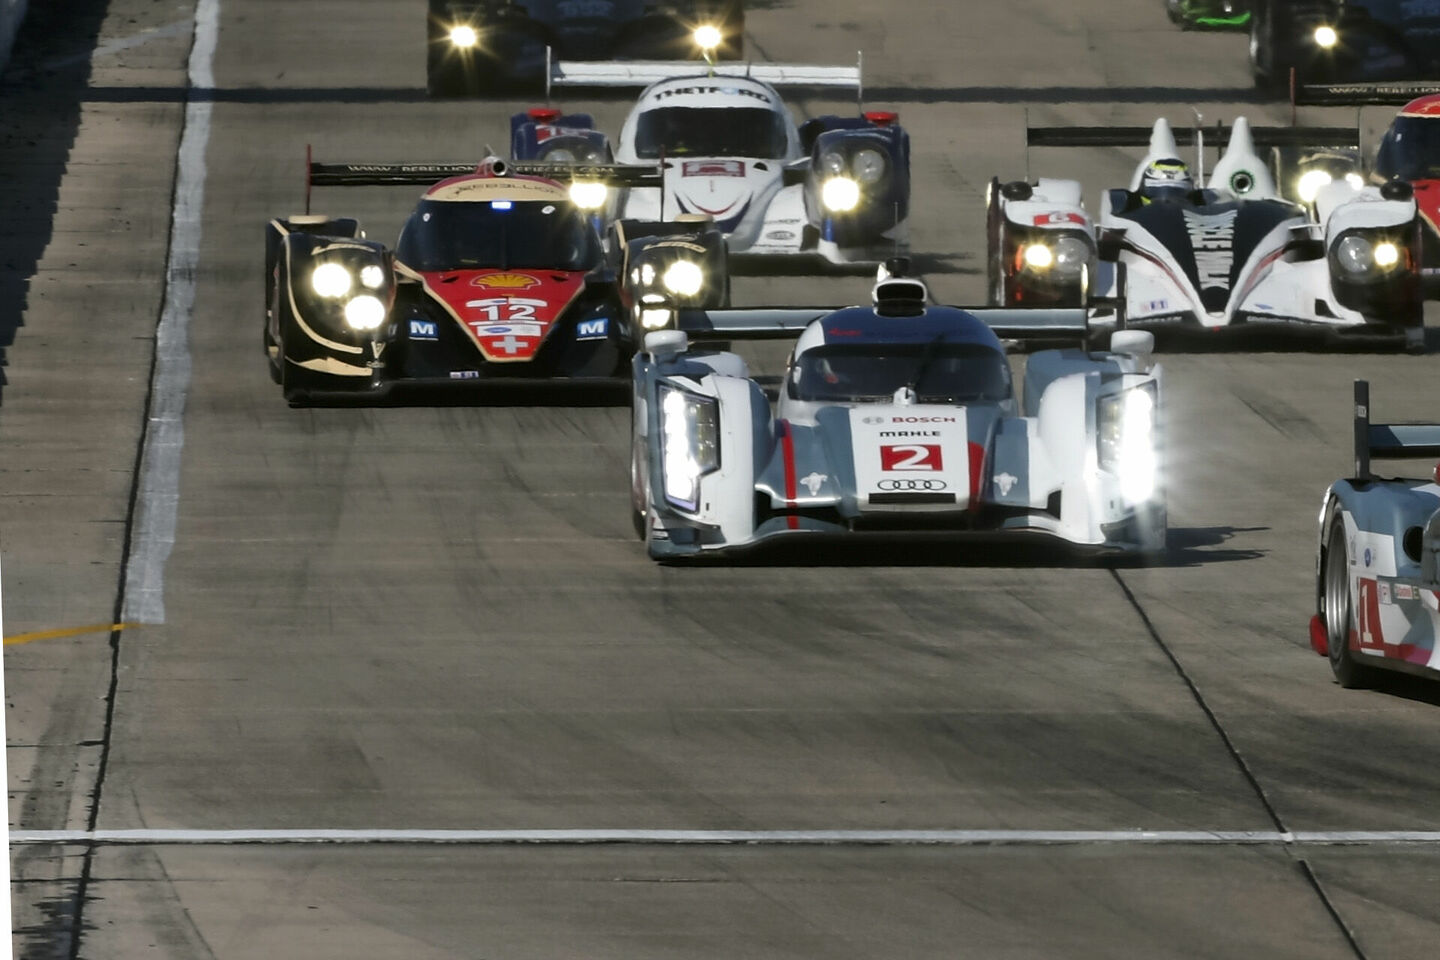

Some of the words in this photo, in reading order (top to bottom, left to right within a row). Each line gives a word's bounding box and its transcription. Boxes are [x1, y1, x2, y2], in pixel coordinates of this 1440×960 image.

[653, 86, 772, 104] THETFORD
[479, 304, 537, 321] 12
[891, 444, 934, 471] 2
